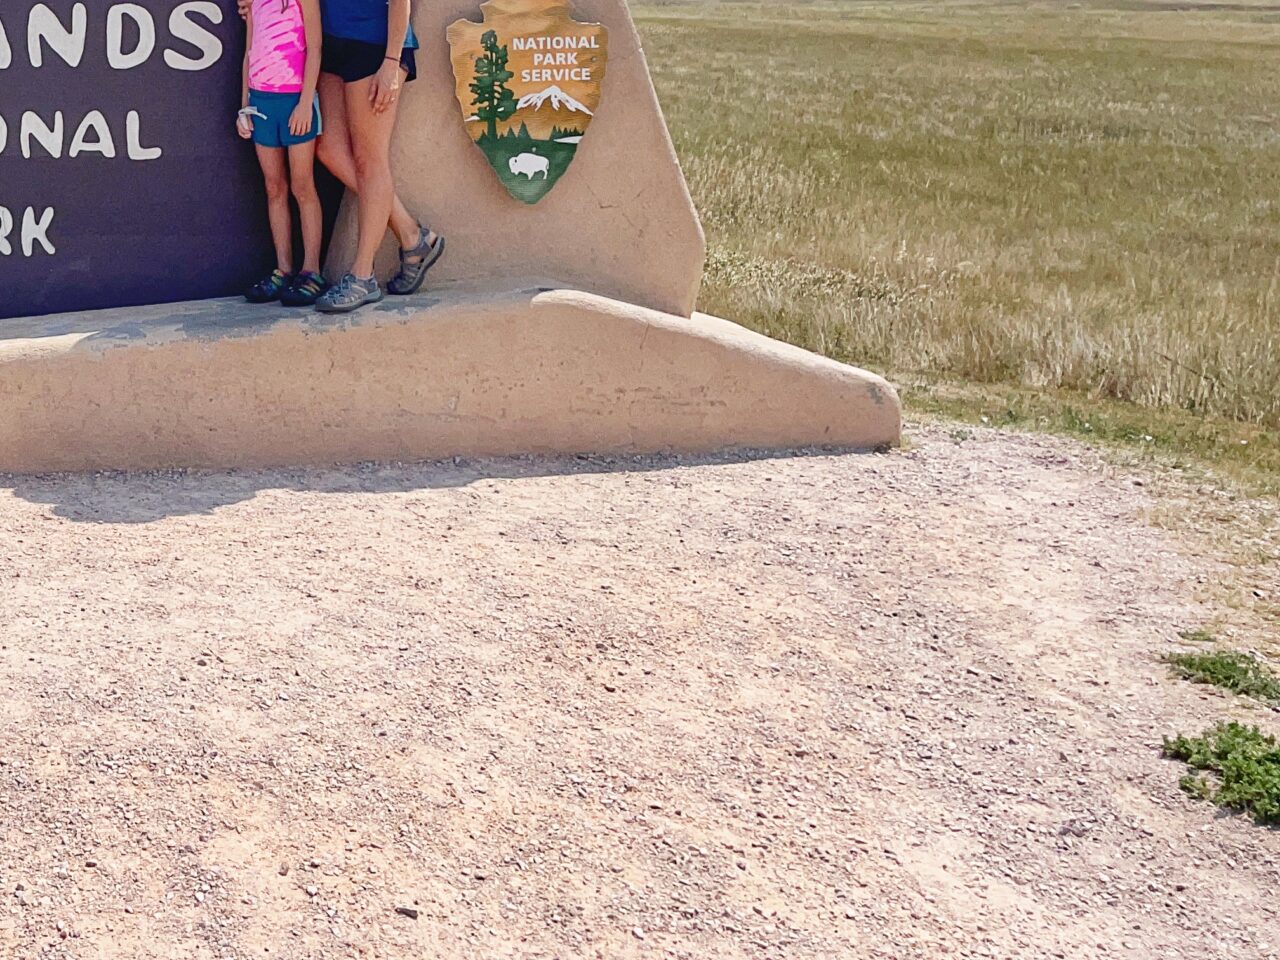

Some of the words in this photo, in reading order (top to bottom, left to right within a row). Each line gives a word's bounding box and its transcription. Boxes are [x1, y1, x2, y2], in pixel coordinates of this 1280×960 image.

[512, 35, 600, 51] NATIONAL
[533, 52, 578, 65] PARK
[521, 68, 591, 82] SERVICE
